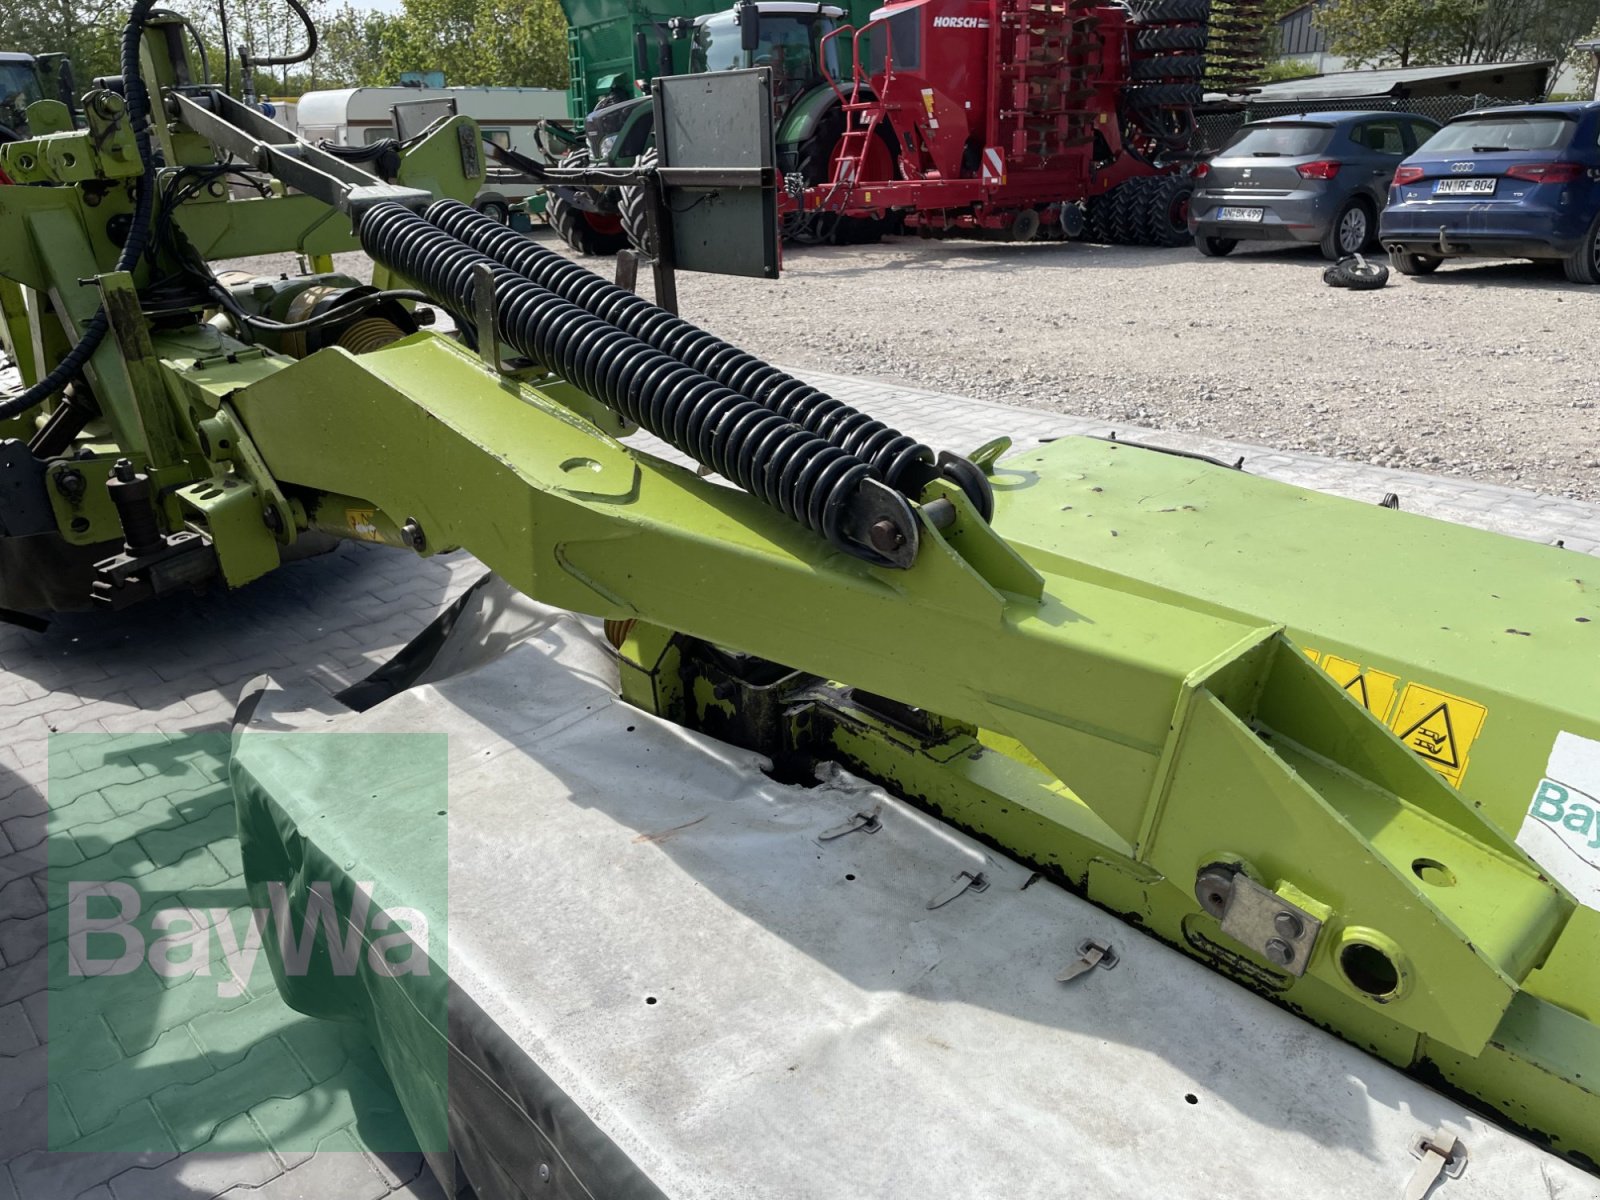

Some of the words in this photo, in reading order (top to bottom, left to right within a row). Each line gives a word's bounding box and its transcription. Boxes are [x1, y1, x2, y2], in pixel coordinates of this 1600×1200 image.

[933, 16, 978, 28] HORSCH
[1439, 180, 1453, 191] AN
[1457, 180, 1472, 191] RF
[1473, 180, 1494, 191] 804
[1223, 207, 1232, 217] AN
[1235, 208, 1246, 218] BK
[1247, 208, 1262, 219] 499
